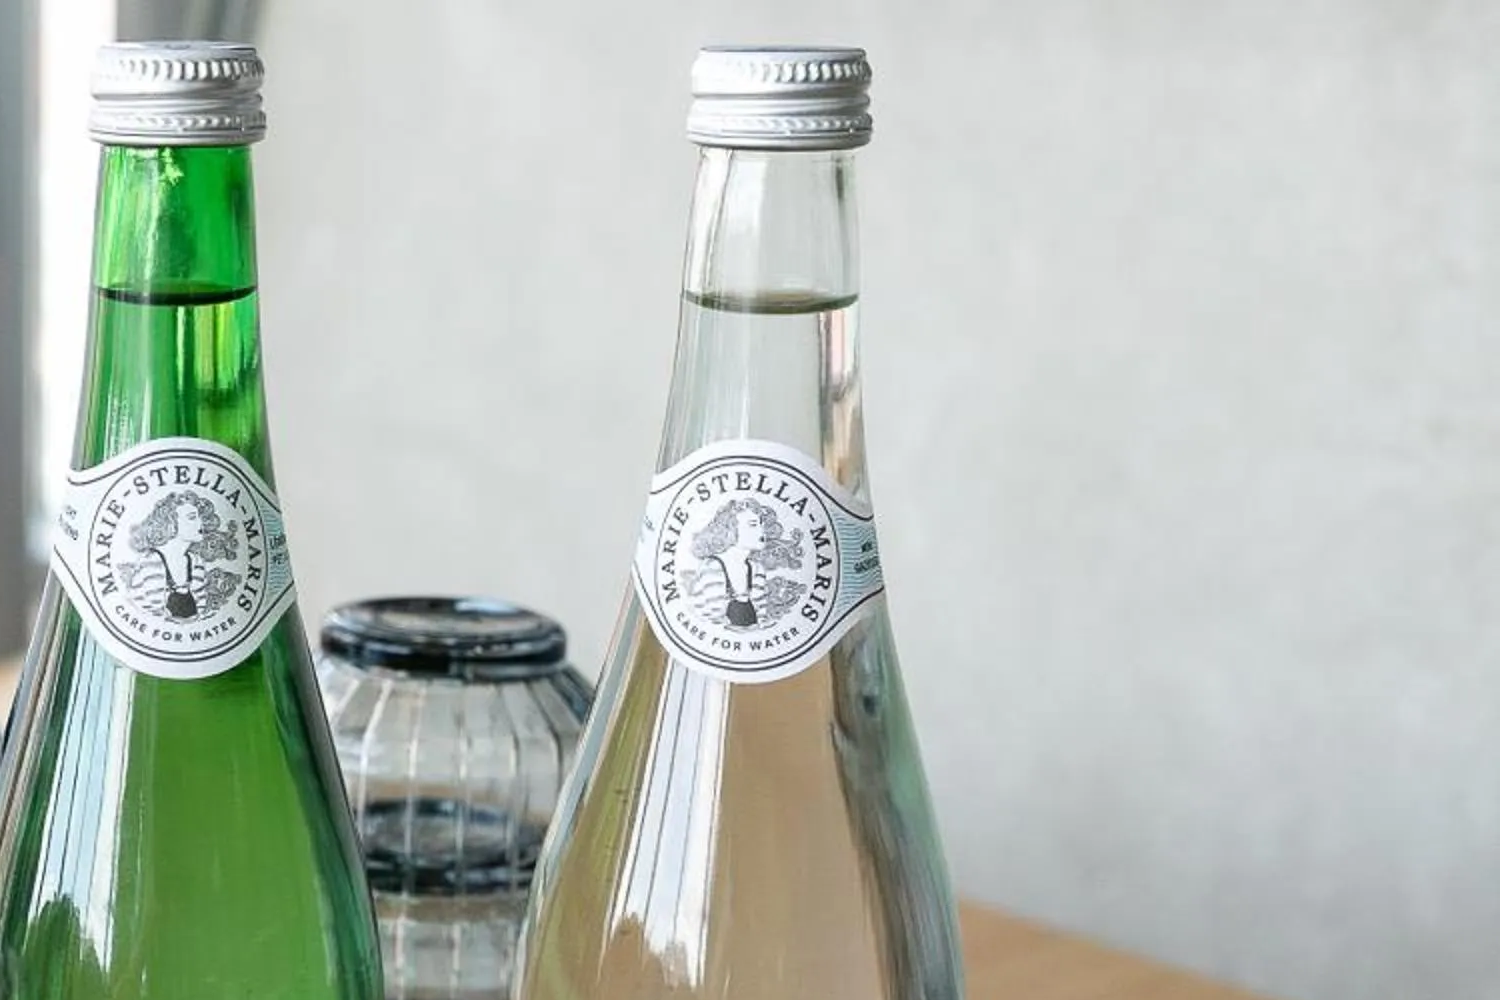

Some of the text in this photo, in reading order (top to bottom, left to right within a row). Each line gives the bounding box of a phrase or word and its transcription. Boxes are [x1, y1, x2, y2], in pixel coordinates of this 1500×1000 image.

[115, 604, 237, 642] CARE FOR WATER
[676, 612, 800, 651] CARE FOR WATER
